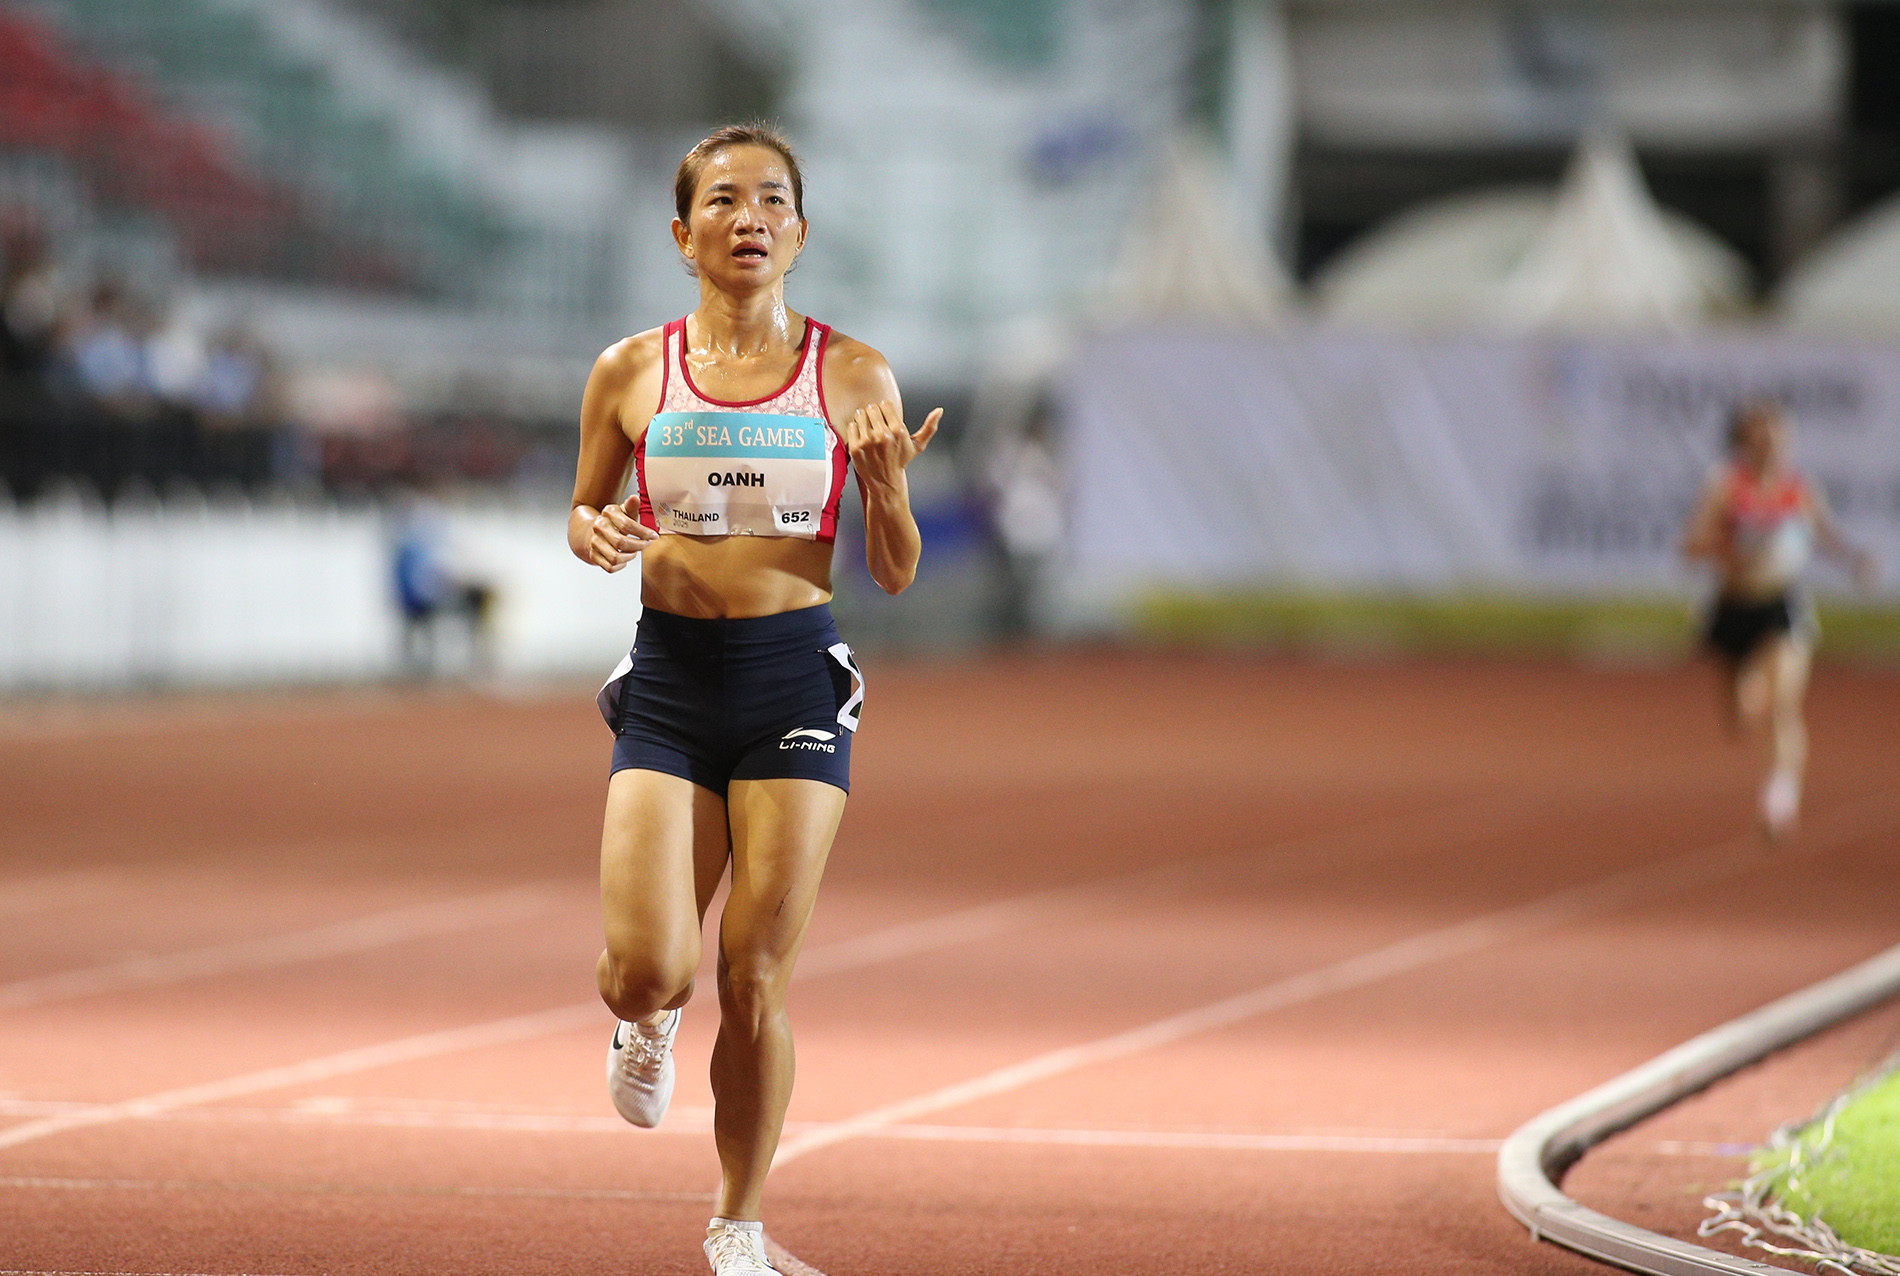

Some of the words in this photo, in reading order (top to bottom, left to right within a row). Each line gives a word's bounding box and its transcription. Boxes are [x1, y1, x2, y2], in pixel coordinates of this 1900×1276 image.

[661, 419, 694, 446] 33rd
[696, 425, 732, 446] SEA
[738, 426, 805, 448] GAMES
[707, 472, 765, 487] OANH
[672, 509, 720, 522] THAILAND
[781, 511, 810, 524] 652
[779, 741, 836, 753] LI-NING
